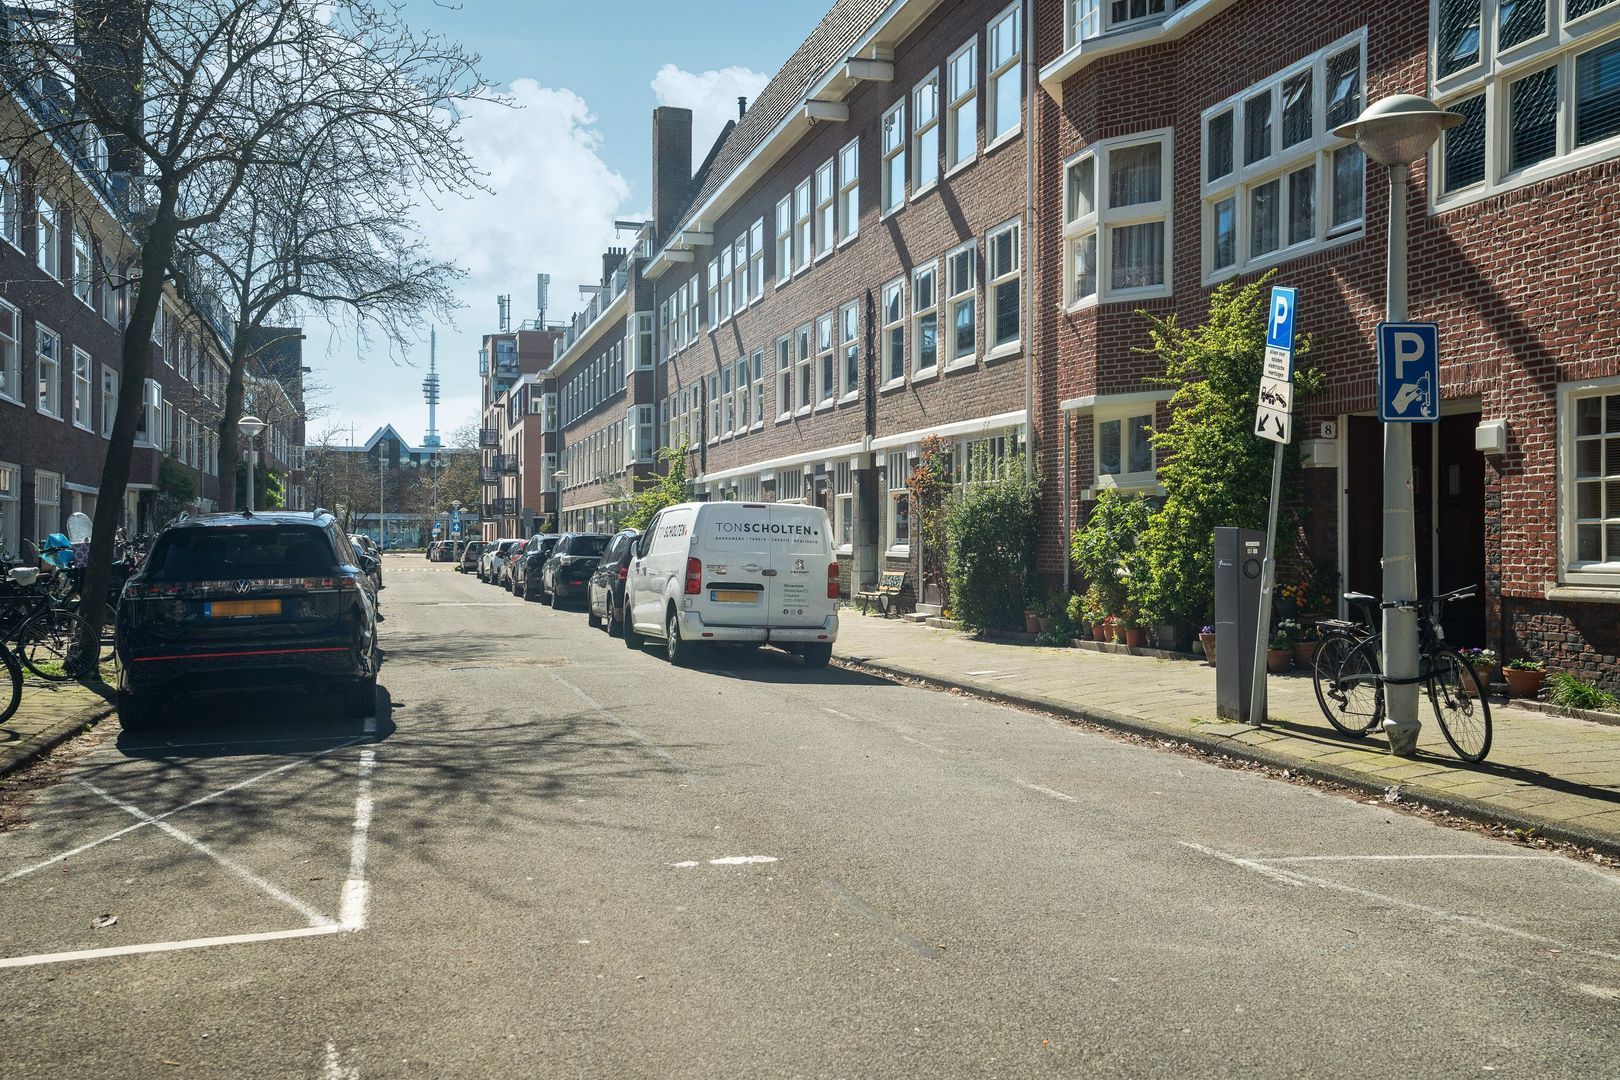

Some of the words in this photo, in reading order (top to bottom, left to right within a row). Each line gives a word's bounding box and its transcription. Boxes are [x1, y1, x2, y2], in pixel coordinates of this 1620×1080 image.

[1273, 296, 1287, 339] P
[1394, 332, 1425, 379] P
[1325, 424, 1332, 435] 8
